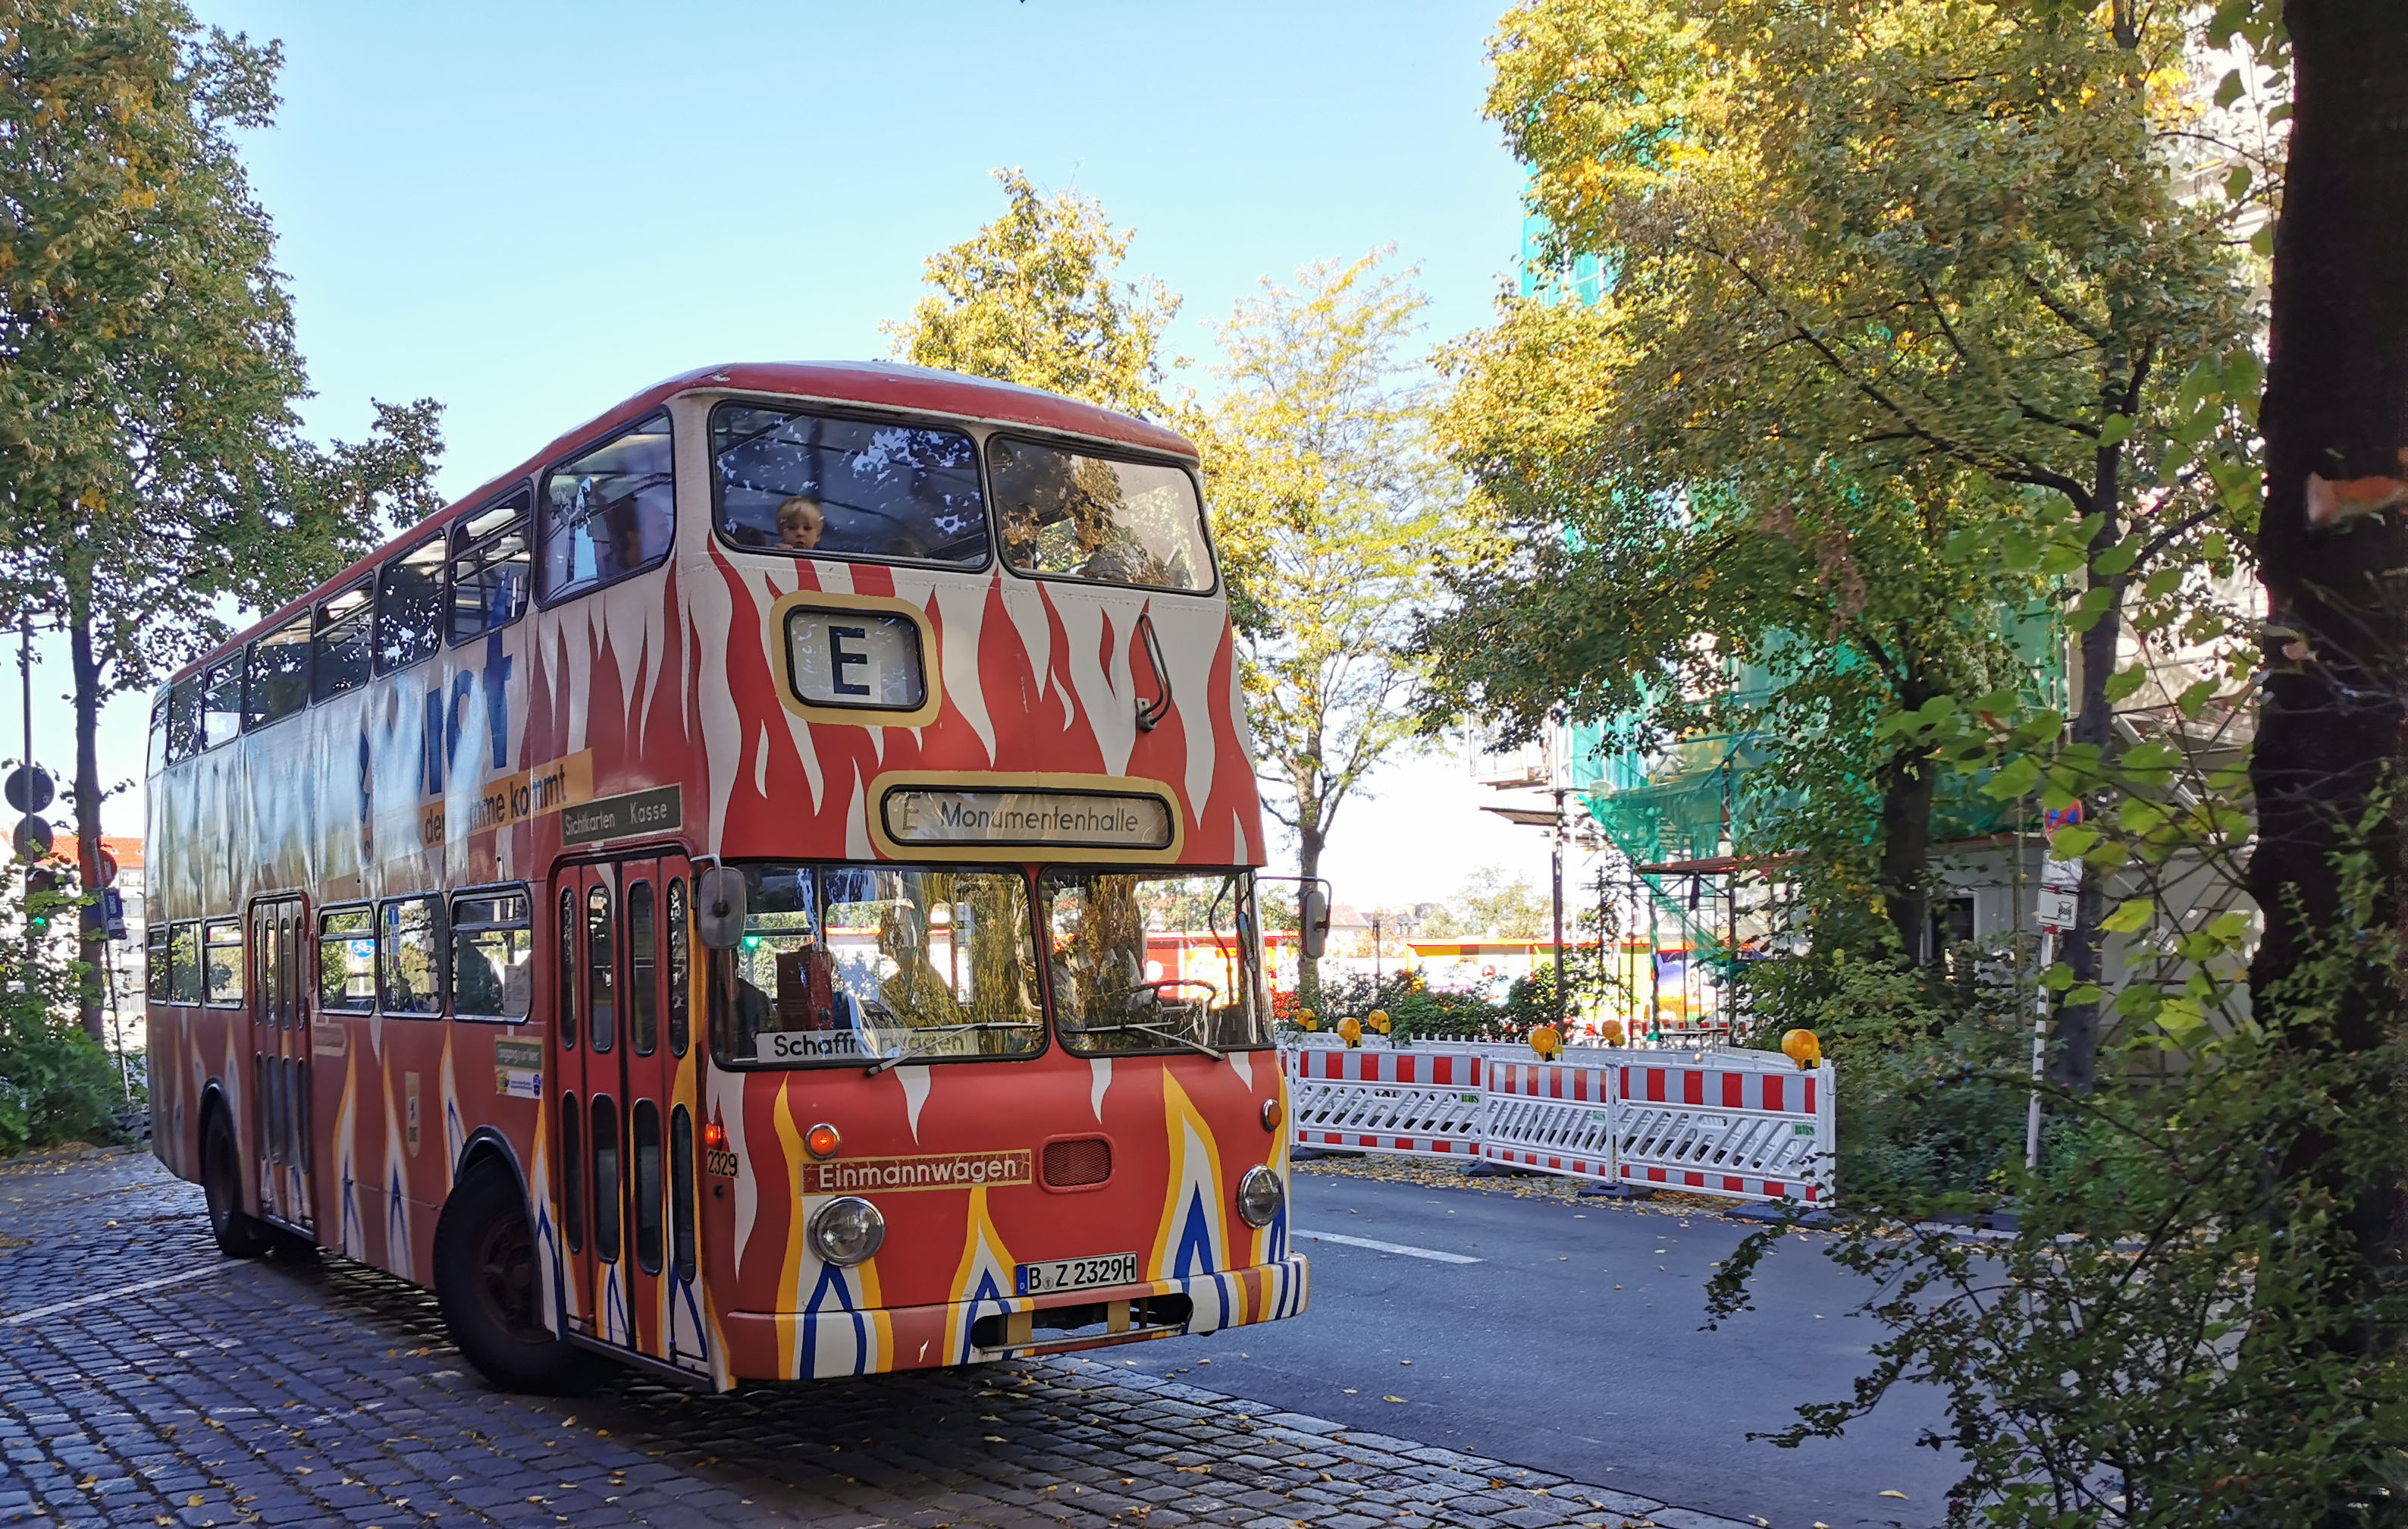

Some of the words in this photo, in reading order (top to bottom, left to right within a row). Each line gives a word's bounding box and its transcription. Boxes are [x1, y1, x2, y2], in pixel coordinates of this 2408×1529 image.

[829, 626, 870, 695] E
[510, 764, 566, 818] kommt
[565, 809, 616, 836] Sichtkarten
[629, 801, 668, 825] Kasse
[940, 801, 1138, 832] Monumentenhalle
[774, 1031, 964, 1057] Schaffnrwagen
[707, 1151, 738, 1176] 2329
[819, 1159, 1017, 1188] Einmannwagen
[1029, 1267, 1041, 1290] B
[1055, 1264, 1068, 1287] Z
[1074, 1256, 1136, 1286] 2329H
